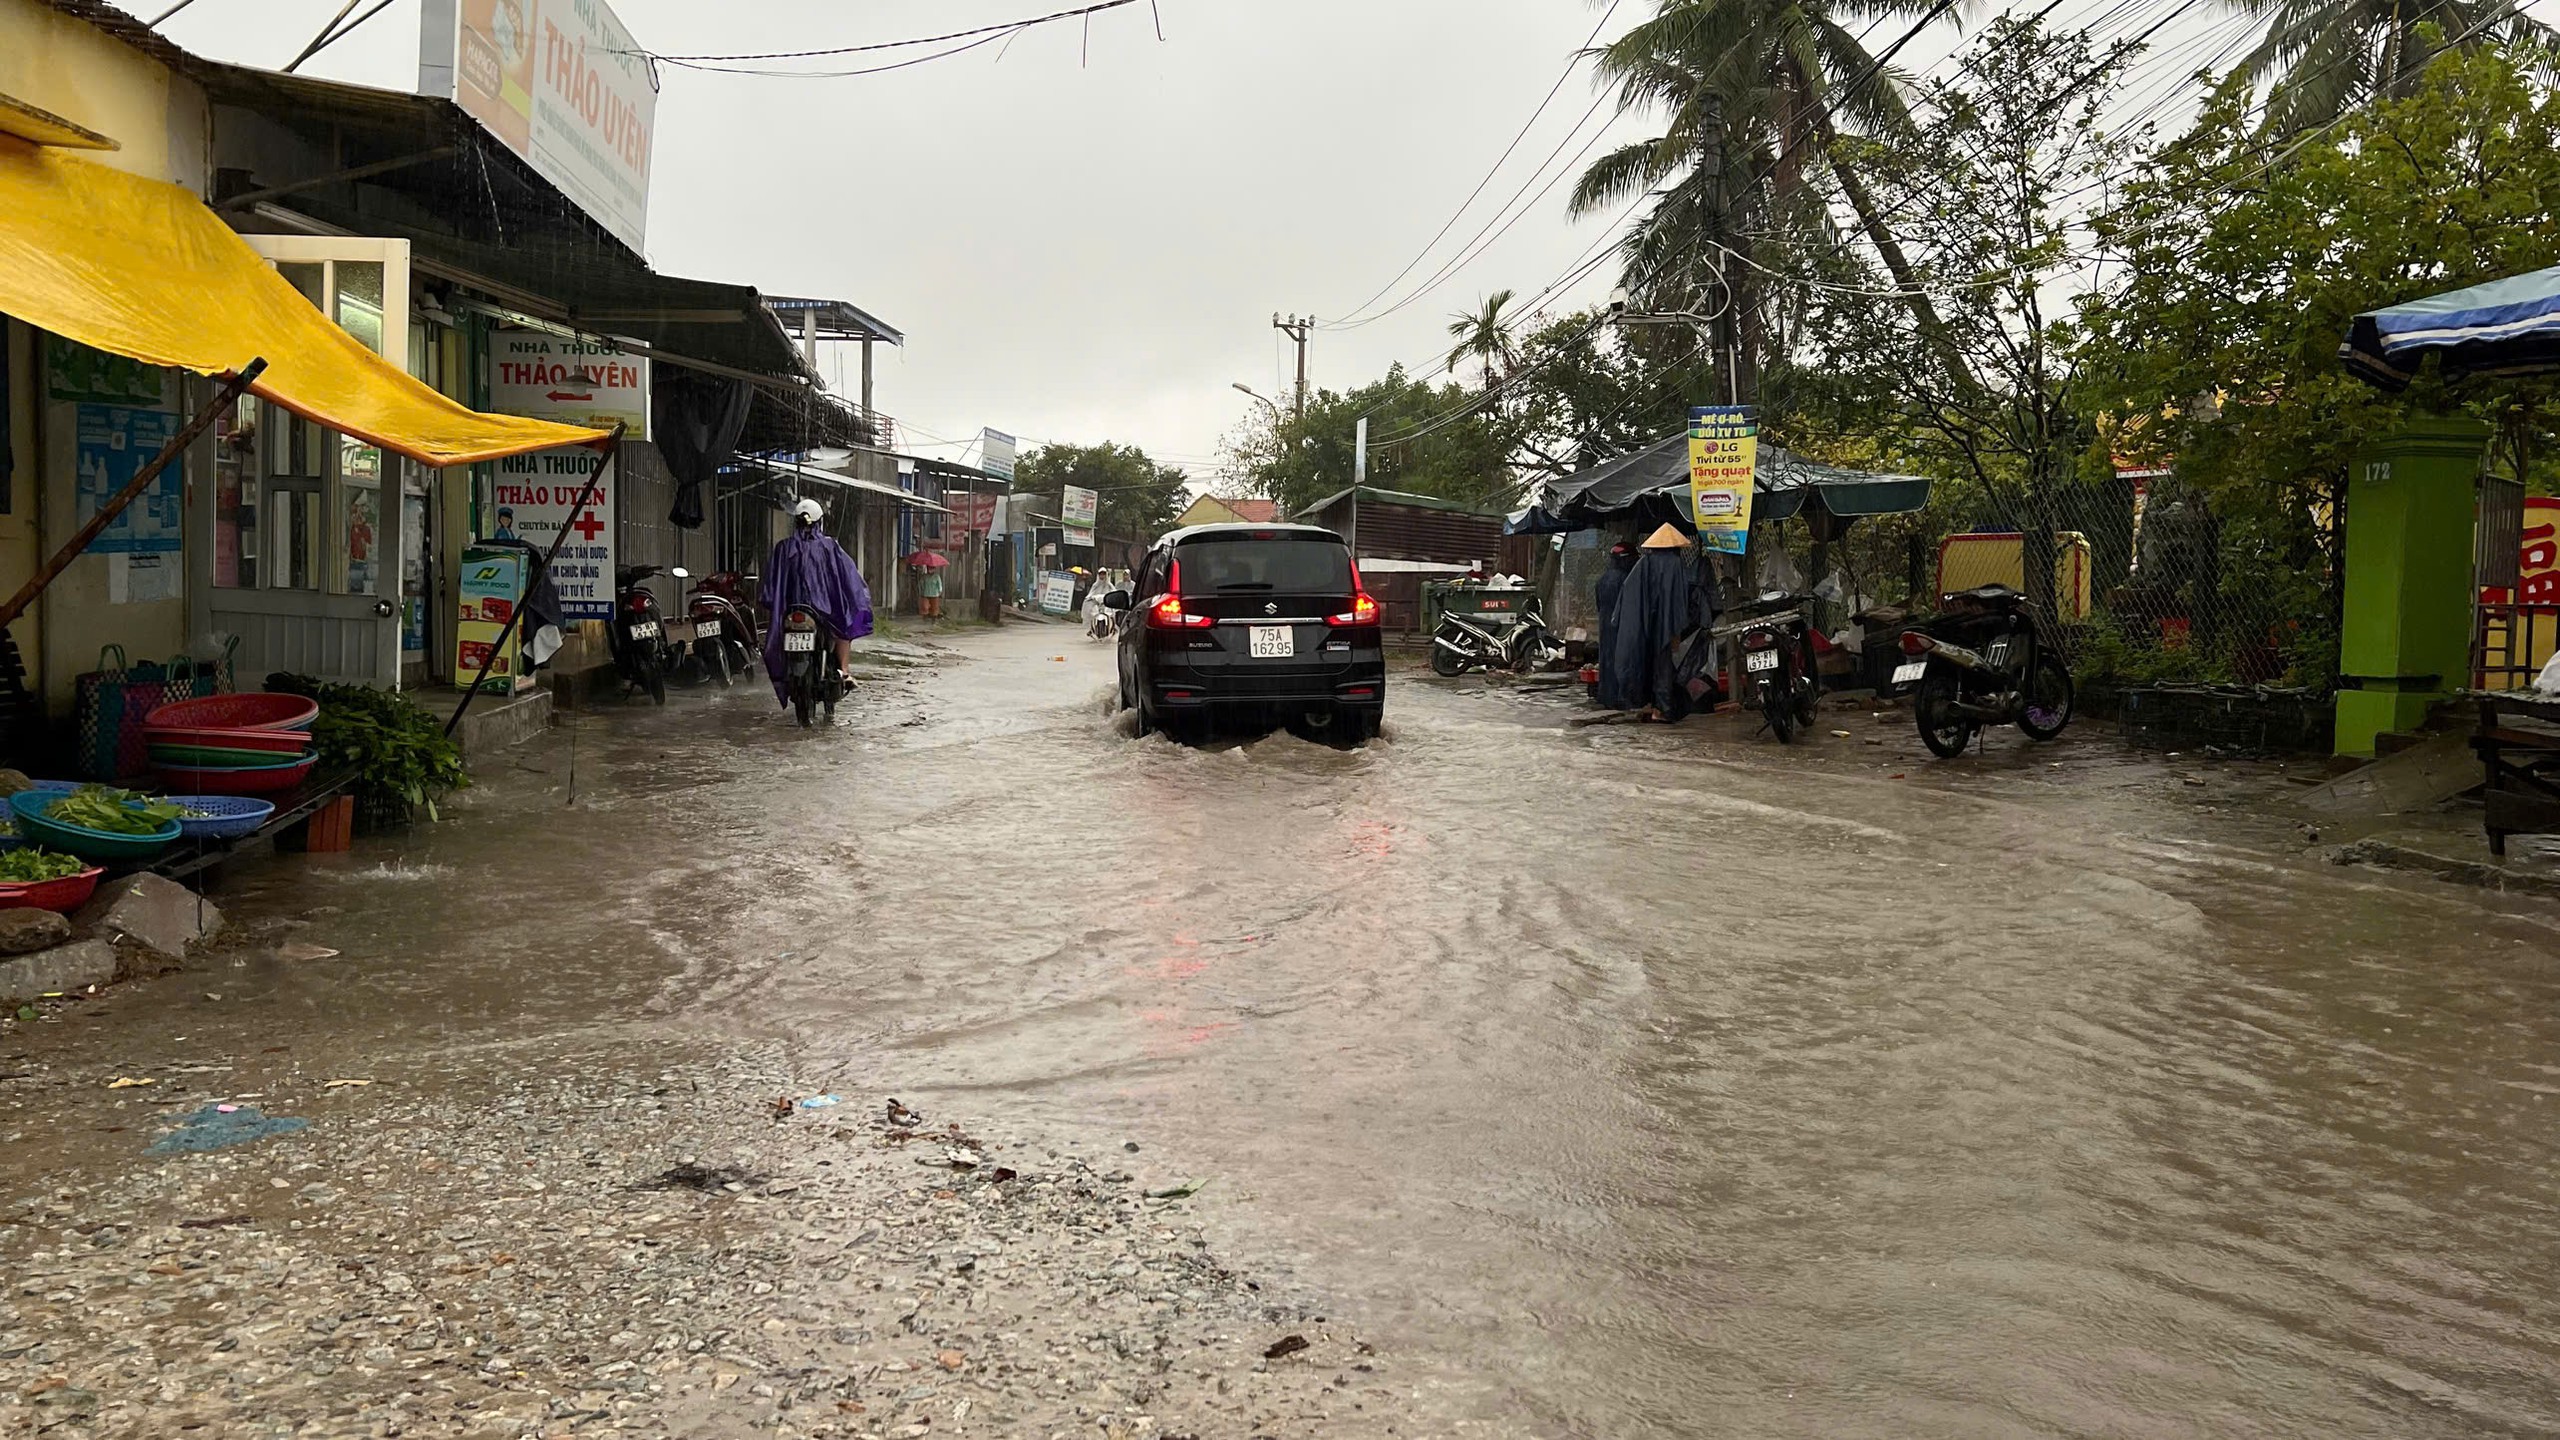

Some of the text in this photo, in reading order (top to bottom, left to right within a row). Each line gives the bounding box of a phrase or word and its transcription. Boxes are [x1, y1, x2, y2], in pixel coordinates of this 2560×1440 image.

[545, 16, 600, 128] THẢO
[604, 85, 648, 179] UYÊN
[509, 340, 626, 357] NHÀ THUC
[499, 357, 637, 388] THẢO YÊN
[1721, 442, 1738, 452] LG
[502, 453, 538, 475] NHÀ
[1696, 455, 1712, 464] Tivi
[1692, 466, 1751, 479] Tặng quạt
[2364, 462, 2391, 482] 172
[496, 478, 548, 506] THẢO
[518, 520, 550, 531] CHUYÊN
[1259, 628, 1282, 641] 75A
